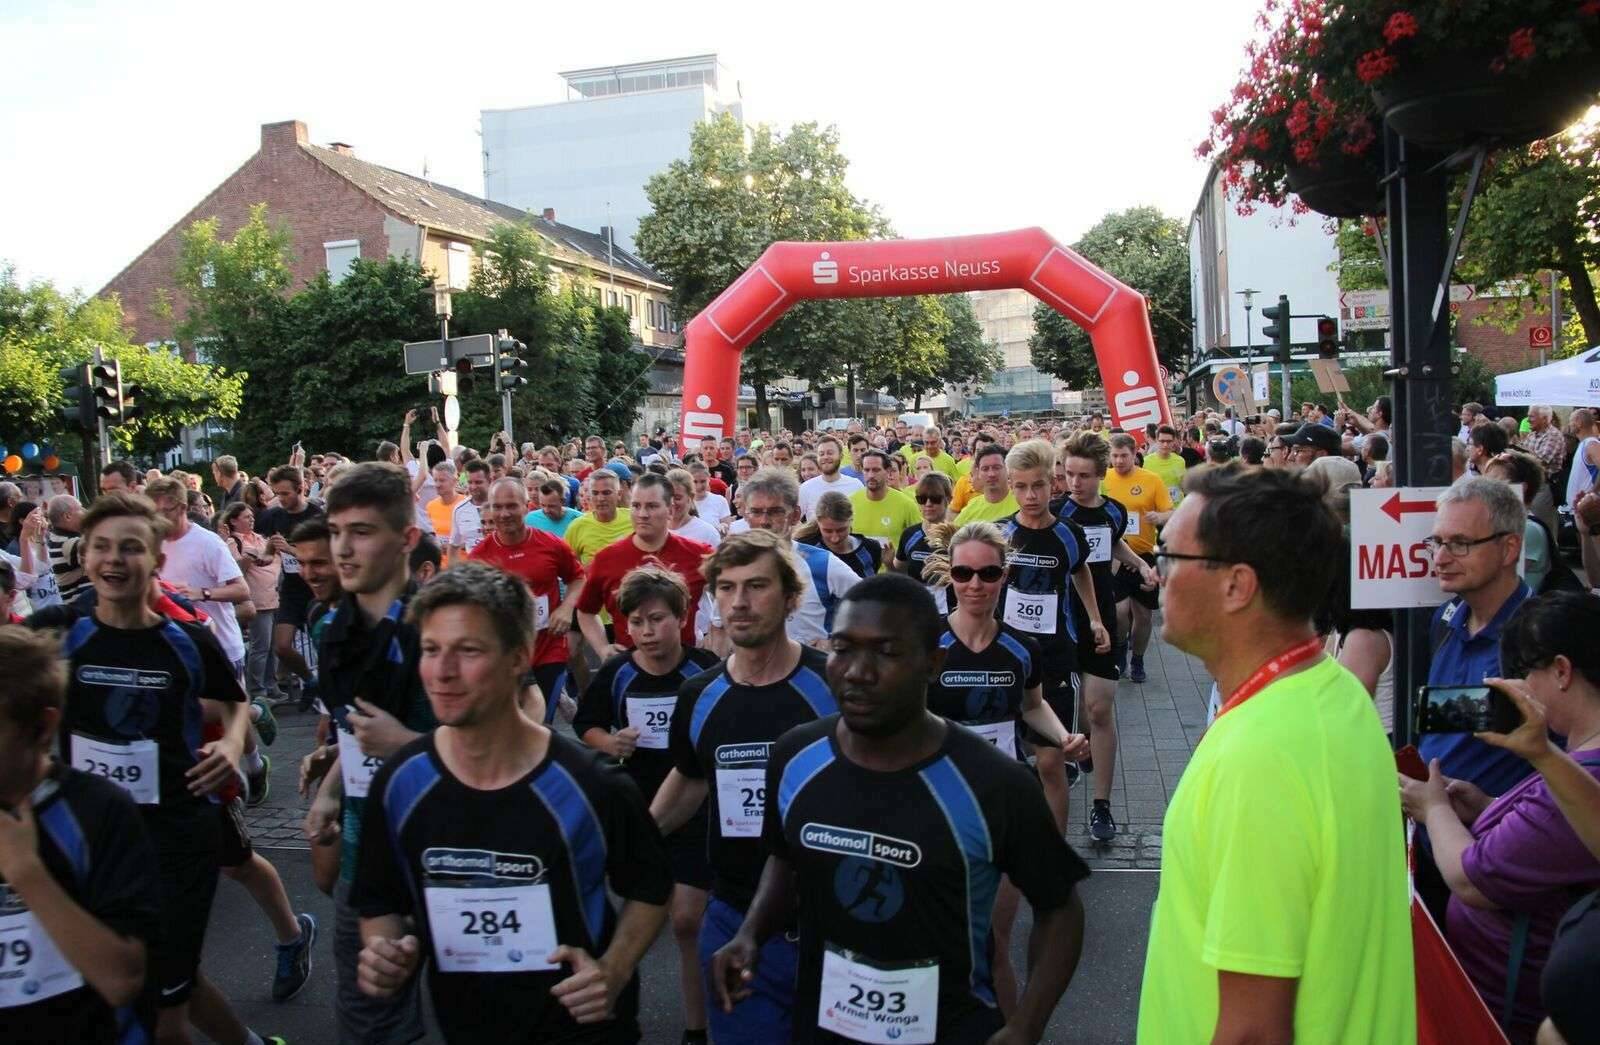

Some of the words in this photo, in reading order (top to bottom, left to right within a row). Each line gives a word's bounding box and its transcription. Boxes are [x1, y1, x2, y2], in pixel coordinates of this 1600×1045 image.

[849, 264, 939, 286] Sparkasse
[944, 260, 1001, 278] Neuss
[1358, 543, 1436, 580] MAS
[1017, 603, 1043, 616] 260
[81, 670, 133, 682] orthomol
[139, 675, 167, 685] sport
[944, 674, 985, 683] orthomol
[989, 675, 1012, 684] sport
[645, 711, 673, 727] 29
[719, 748, 766, 760] orthomol
[84, 759, 142, 782] 2349
[806, 831, 867, 850] orthomol
[874, 843, 912, 861] sport
[427, 854, 490, 868] orthomol
[495, 861, 534, 874] sport
[460, 909, 522, 935] 284
[847, 983, 907, 1014] 293
[834, 1001, 870, 1020] Armel
[873, 1012, 919, 1026] Wonga
